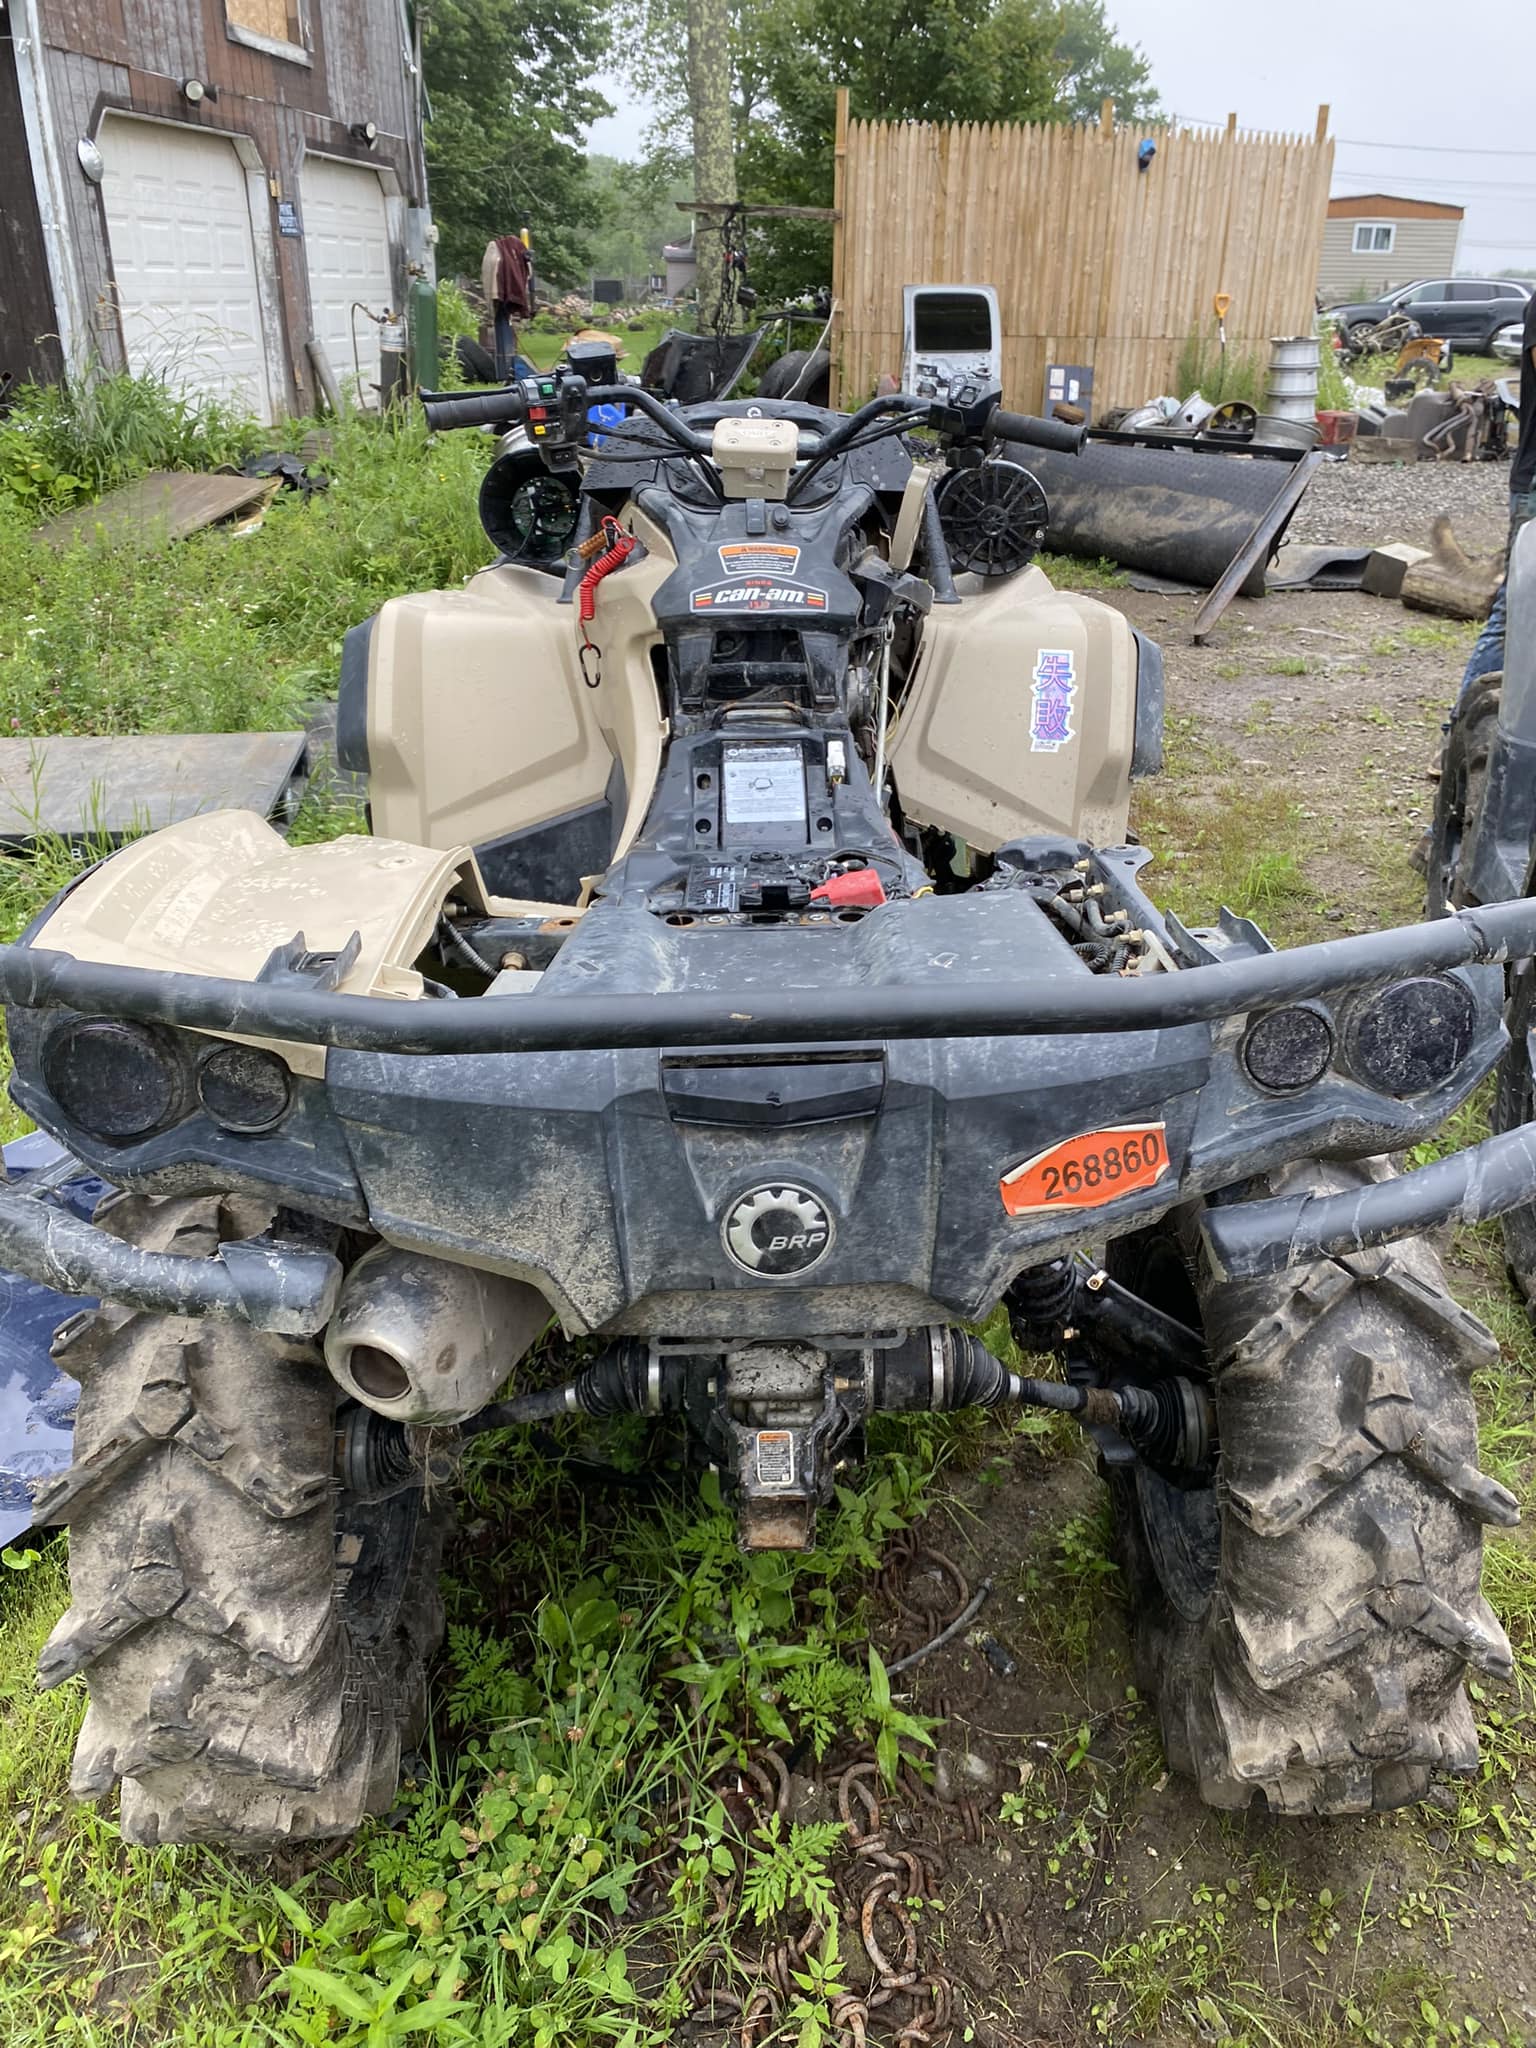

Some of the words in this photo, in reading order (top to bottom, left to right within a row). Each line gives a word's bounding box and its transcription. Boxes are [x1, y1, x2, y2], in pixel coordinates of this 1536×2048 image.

[714, 587, 805, 604] can-am
[1034, 653, 1073, 738] 失敗
[1041, 1133, 1160, 1201] 268860
[768, 1232, 826, 1251] BRP
